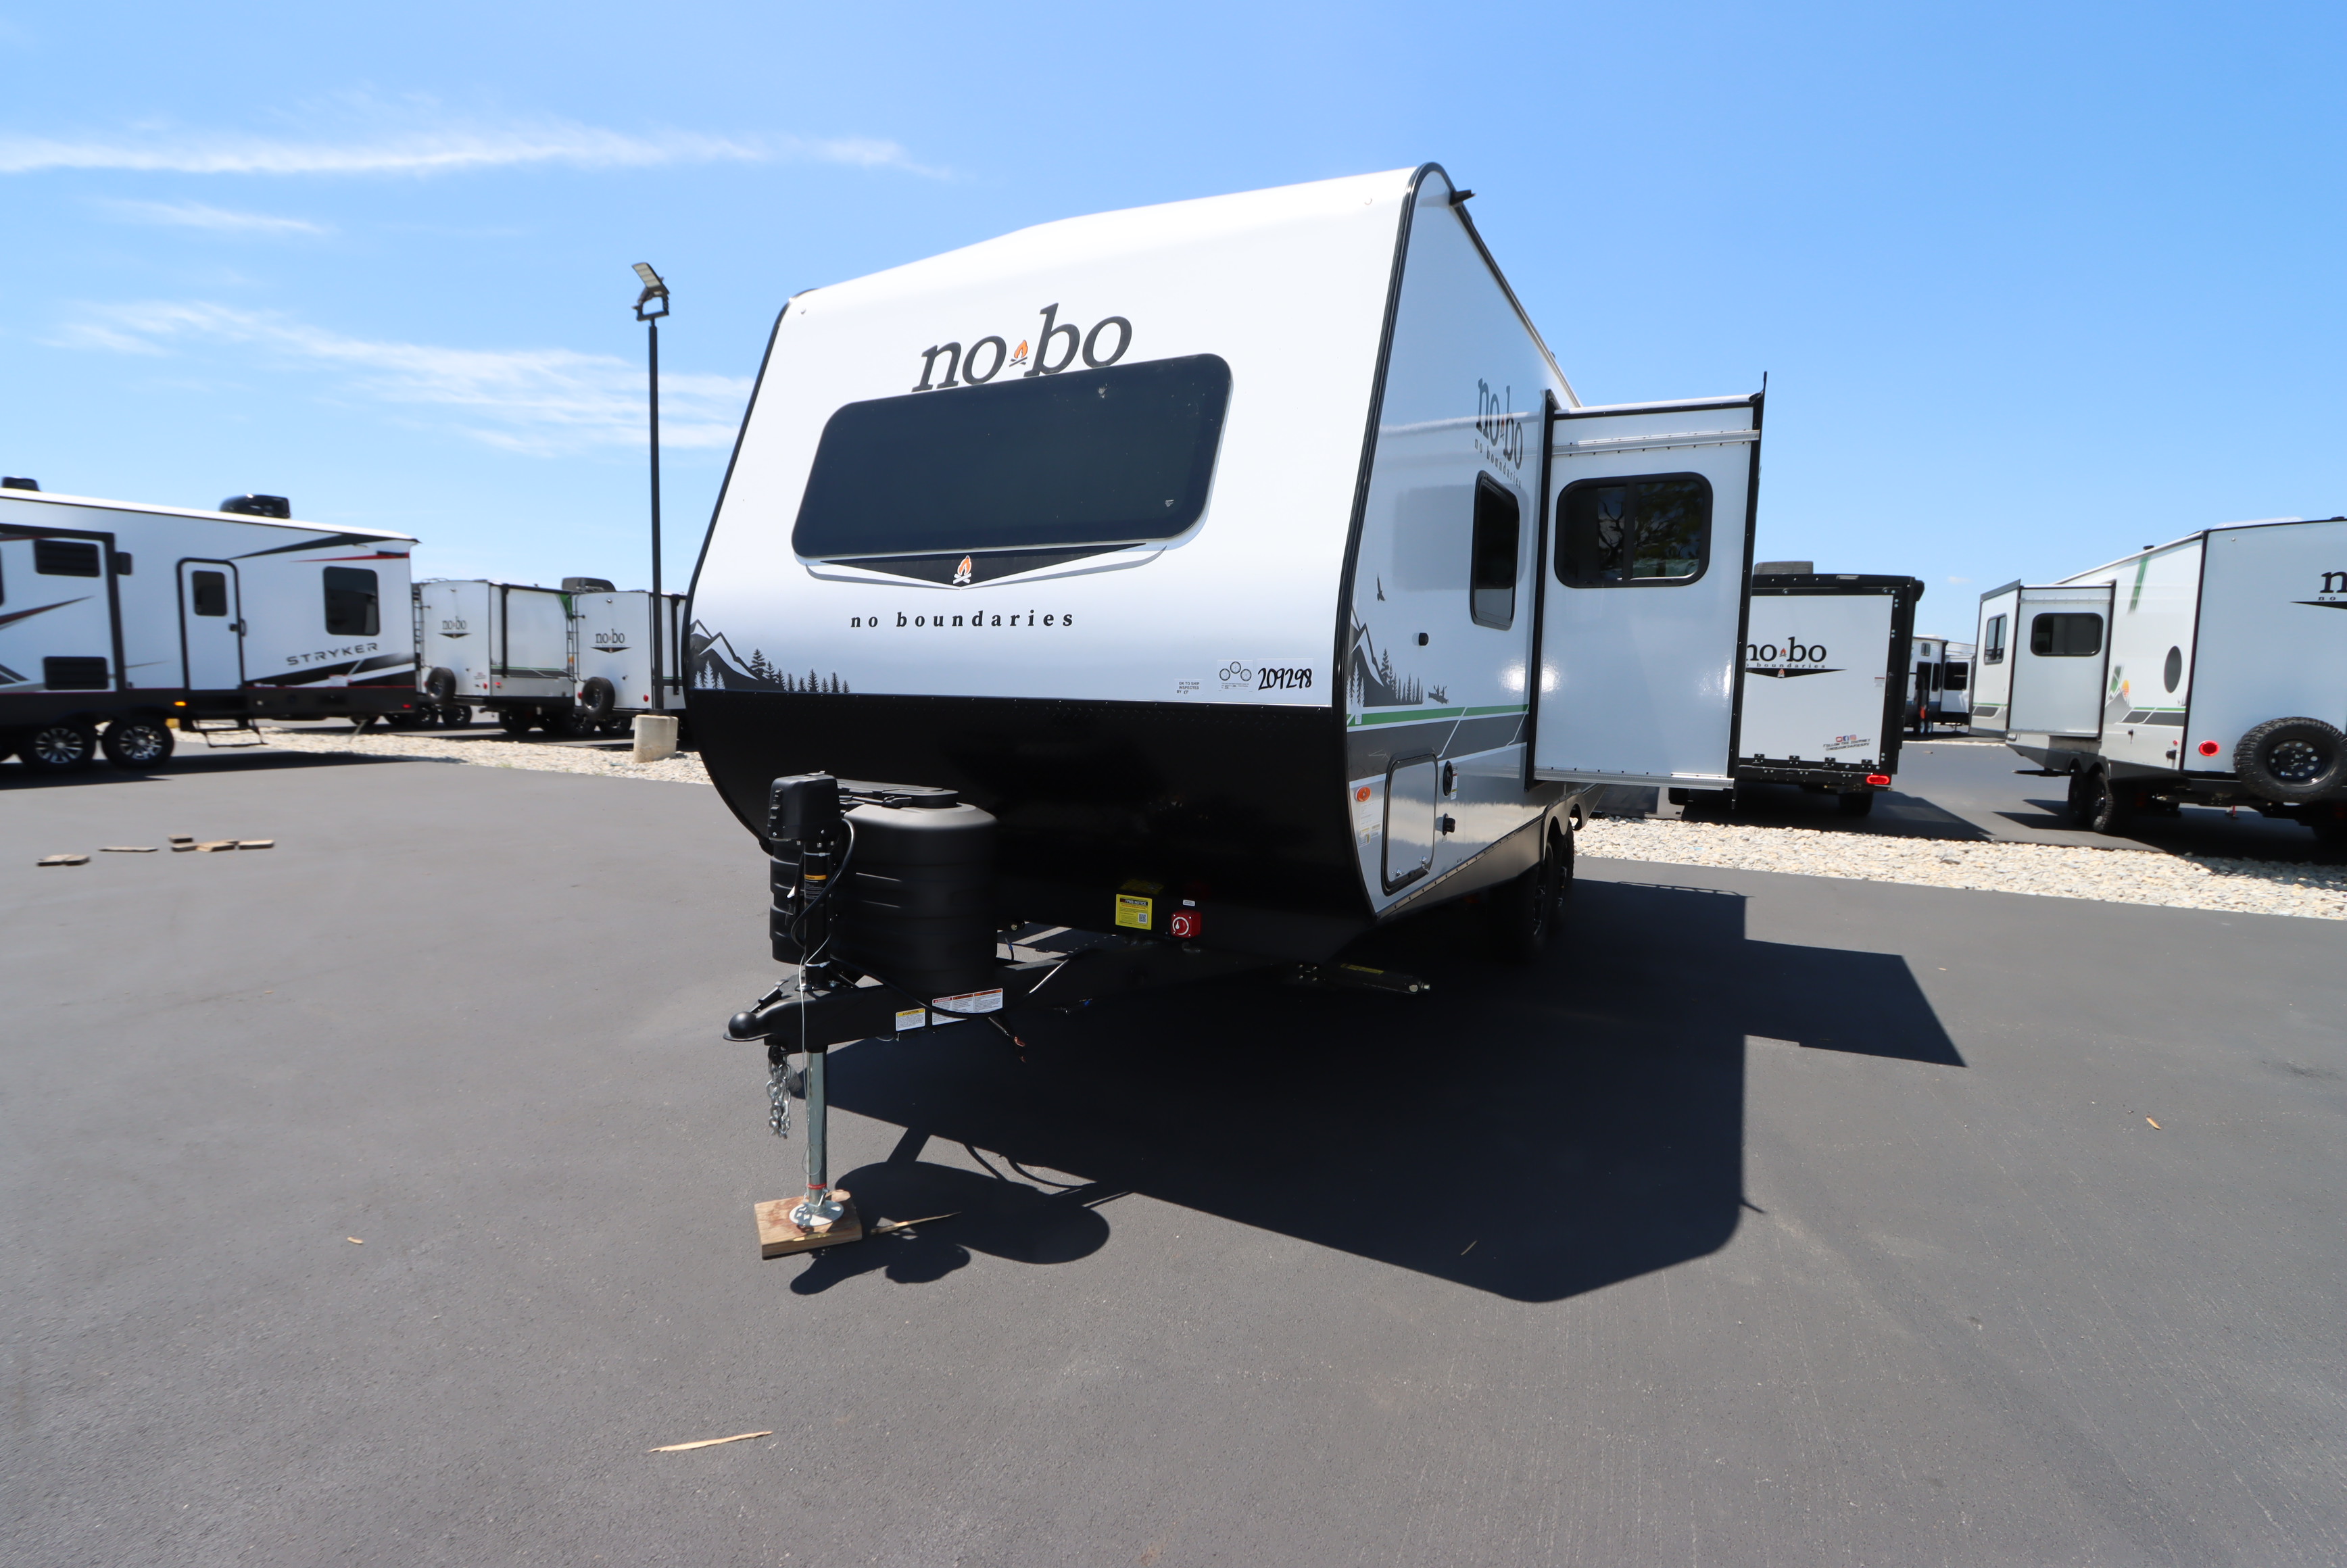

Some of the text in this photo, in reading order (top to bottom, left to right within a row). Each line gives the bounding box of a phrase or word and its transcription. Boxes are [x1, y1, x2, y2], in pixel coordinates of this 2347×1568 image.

[1474, 438, 1522, 489] no boundaries
[850, 609, 1073, 628] no boundaries
[286, 643, 378, 665] STRYKER
[1257, 667, 1312, 691] 209298
